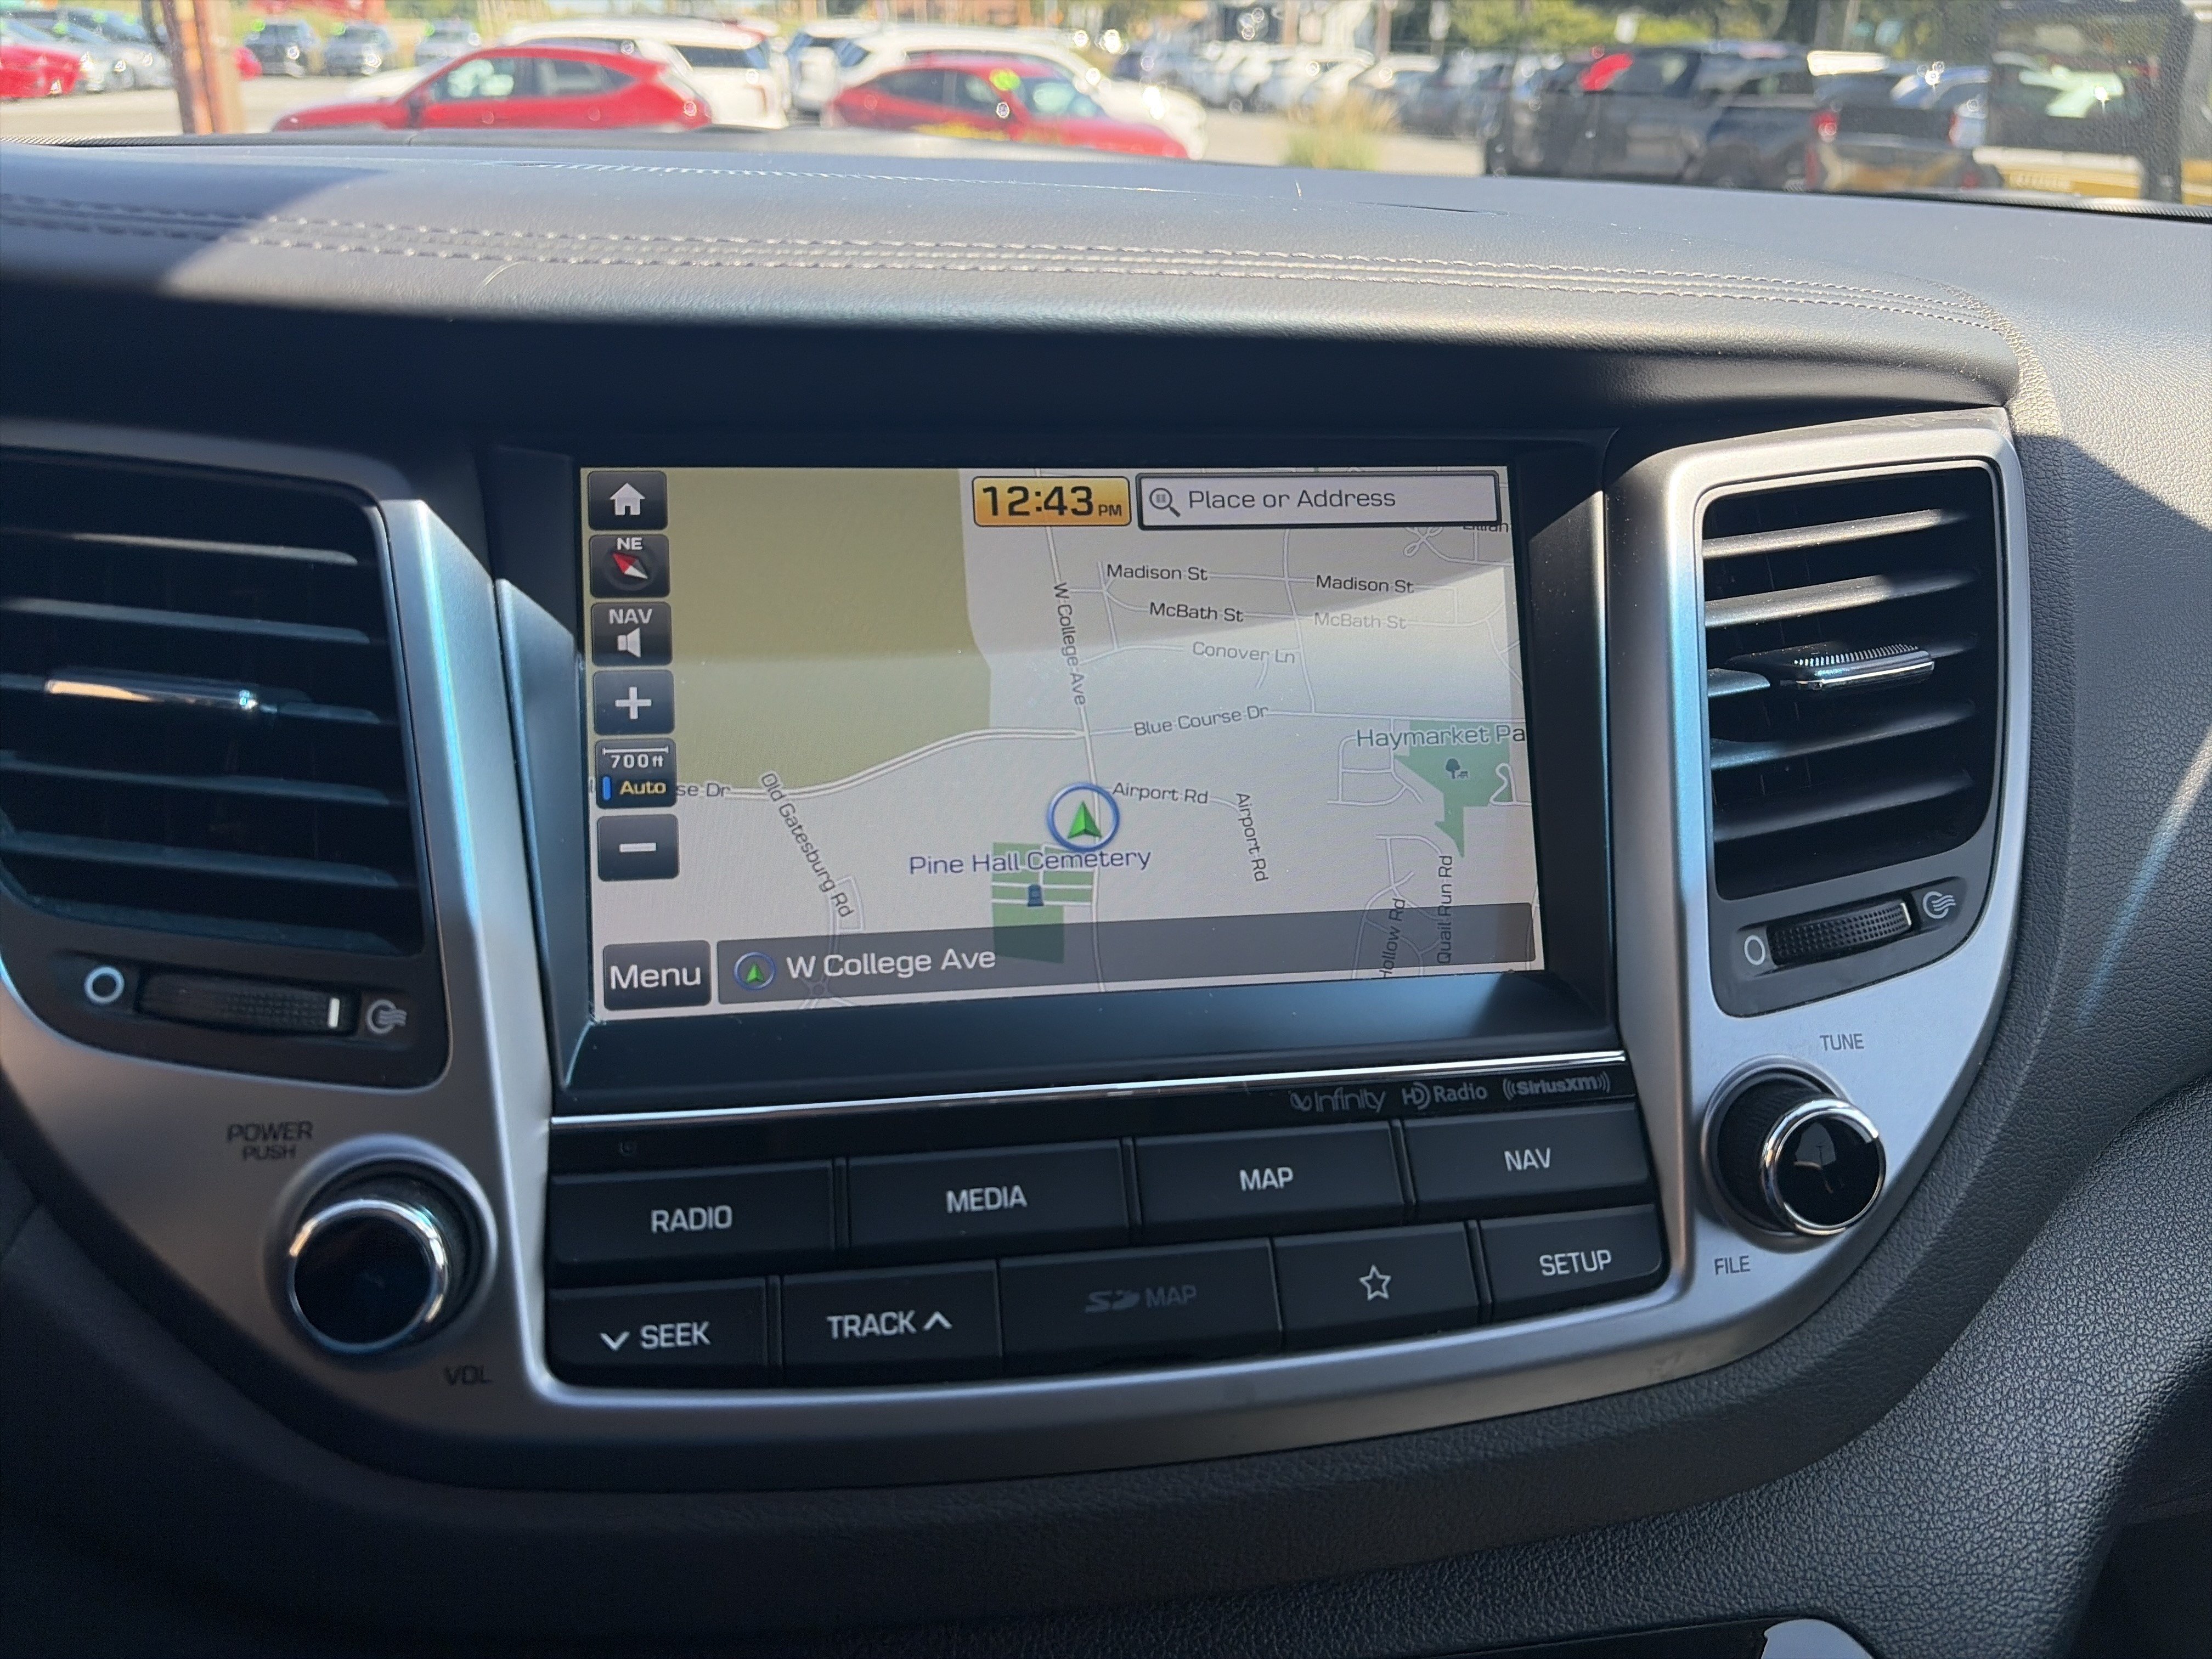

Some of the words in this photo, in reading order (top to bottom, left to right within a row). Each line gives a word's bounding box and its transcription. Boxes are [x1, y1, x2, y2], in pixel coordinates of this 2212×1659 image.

[983, 486, 1093, 517] 12:43
[1098, 504, 1122, 517] PM
[1189, 490, 1255, 509] Place
[1263, 493, 1289, 508] or
[1298, 489, 1396, 508] Address
[617, 537, 643, 550] NE
[1107, 563, 1182, 580] Madison
[1187, 566, 1208, 582] St
[1316, 574, 1389, 592] Madison
[1394, 579, 1414, 593] St
[1053, 582, 1069, 599] W
[609, 608, 653, 625] NAV
[1150, 602, 1218, 621] McBath
[1223, 607, 1244, 622] St
[1314, 612, 1381, 629] McBath
[1386, 614, 1407, 629] St
[1058, 604, 1079, 667] College
[1193, 641, 1268, 661] Conover
[1275, 648, 1295, 663] Ln
[1070, 672, 1086, 706] Ave
[1134, 719, 1172, 736] Blue
[1178, 709, 1242, 731] Course
[1247, 705, 1268, 720] Dr
[1356, 726, 1489, 750] Haymarket
[619, 780, 667, 795] Auto
[706, 782, 731, 797] Dr
[1113, 782, 1178, 802] Airport
[1184, 789, 1208, 804] Rd
[761, 773, 788, 802] Old
[778, 803, 836, 892] Gatesburg
[830, 891, 855, 917] Rd
[1236, 793, 1261, 854] Airport
[1251, 858, 1269, 882] Rd
[910, 856, 964, 874] Pine
[973, 852, 1019, 872] Hall
[1027, 850, 1151, 871] Cemetery
[1438, 855, 1453, 878] Rd
[1389, 898, 1406, 921] Rd
[1437, 883, 1452, 916] Run
[1437, 921, 1452, 964] Quail
[786, 956, 816, 979] W
[824, 952, 932, 978] College
[940, 948, 996, 970] Ave
[611, 964, 701, 989] Menu
[1820, 1033, 1865, 1051] TUNE
[1433, 1083, 1488, 1103] Radio
[227, 1120, 313, 1142] POWER
[242, 1144, 297, 1161] PUSH
[1504, 1148, 1551, 1171] NAV
[1239, 1167, 1294, 1191] MAP
[946, 1185, 1028, 1213] MEDIA
[651, 1205, 732, 1234] RADIO
[1539, 1249, 1612, 1276] SETUP
[1714, 1255, 1750, 1275] FILE
[1146, 1284, 1197, 1308] MAP
[640, 1321, 711, 1349] SEEK
[827, 1310, 917, 1340] TRACK
[444, 1365, 492, 1385] VOL
